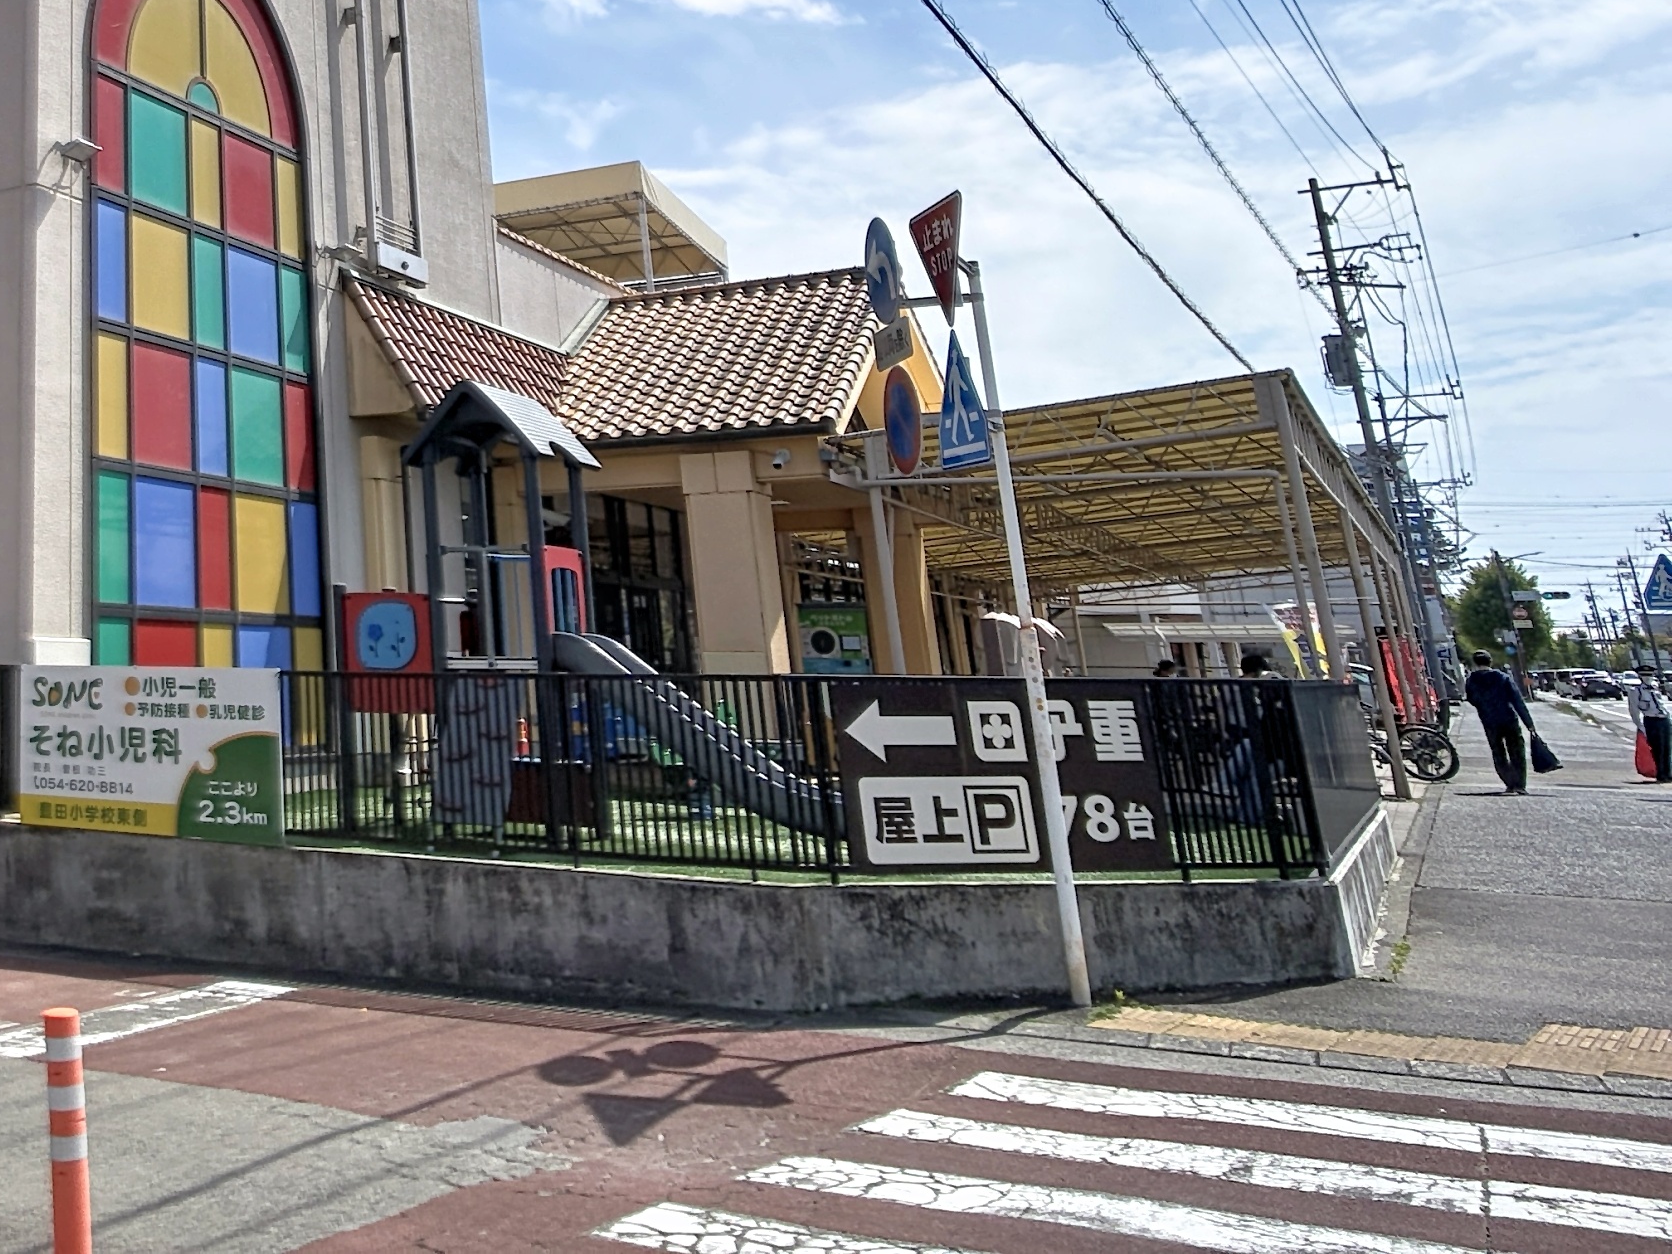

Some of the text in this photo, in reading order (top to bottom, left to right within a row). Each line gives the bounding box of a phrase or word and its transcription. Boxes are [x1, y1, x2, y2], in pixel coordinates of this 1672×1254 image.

[922, 213, 954, 253] 止まれ
[930, 247, 954, 277] STOP
[32, 676, 103, 710] SONE
[142, 676, 217, 699] 小児一般
[137, 702, 266, 721] 予防接種 乳児健診
[29, 724, 183, 765] そね小児科
[38, 777, 134, 795] 054-620-8814
[208, 780, 259, 797] ここより
[39, 802, 148, 827] 豊田小学校東側
